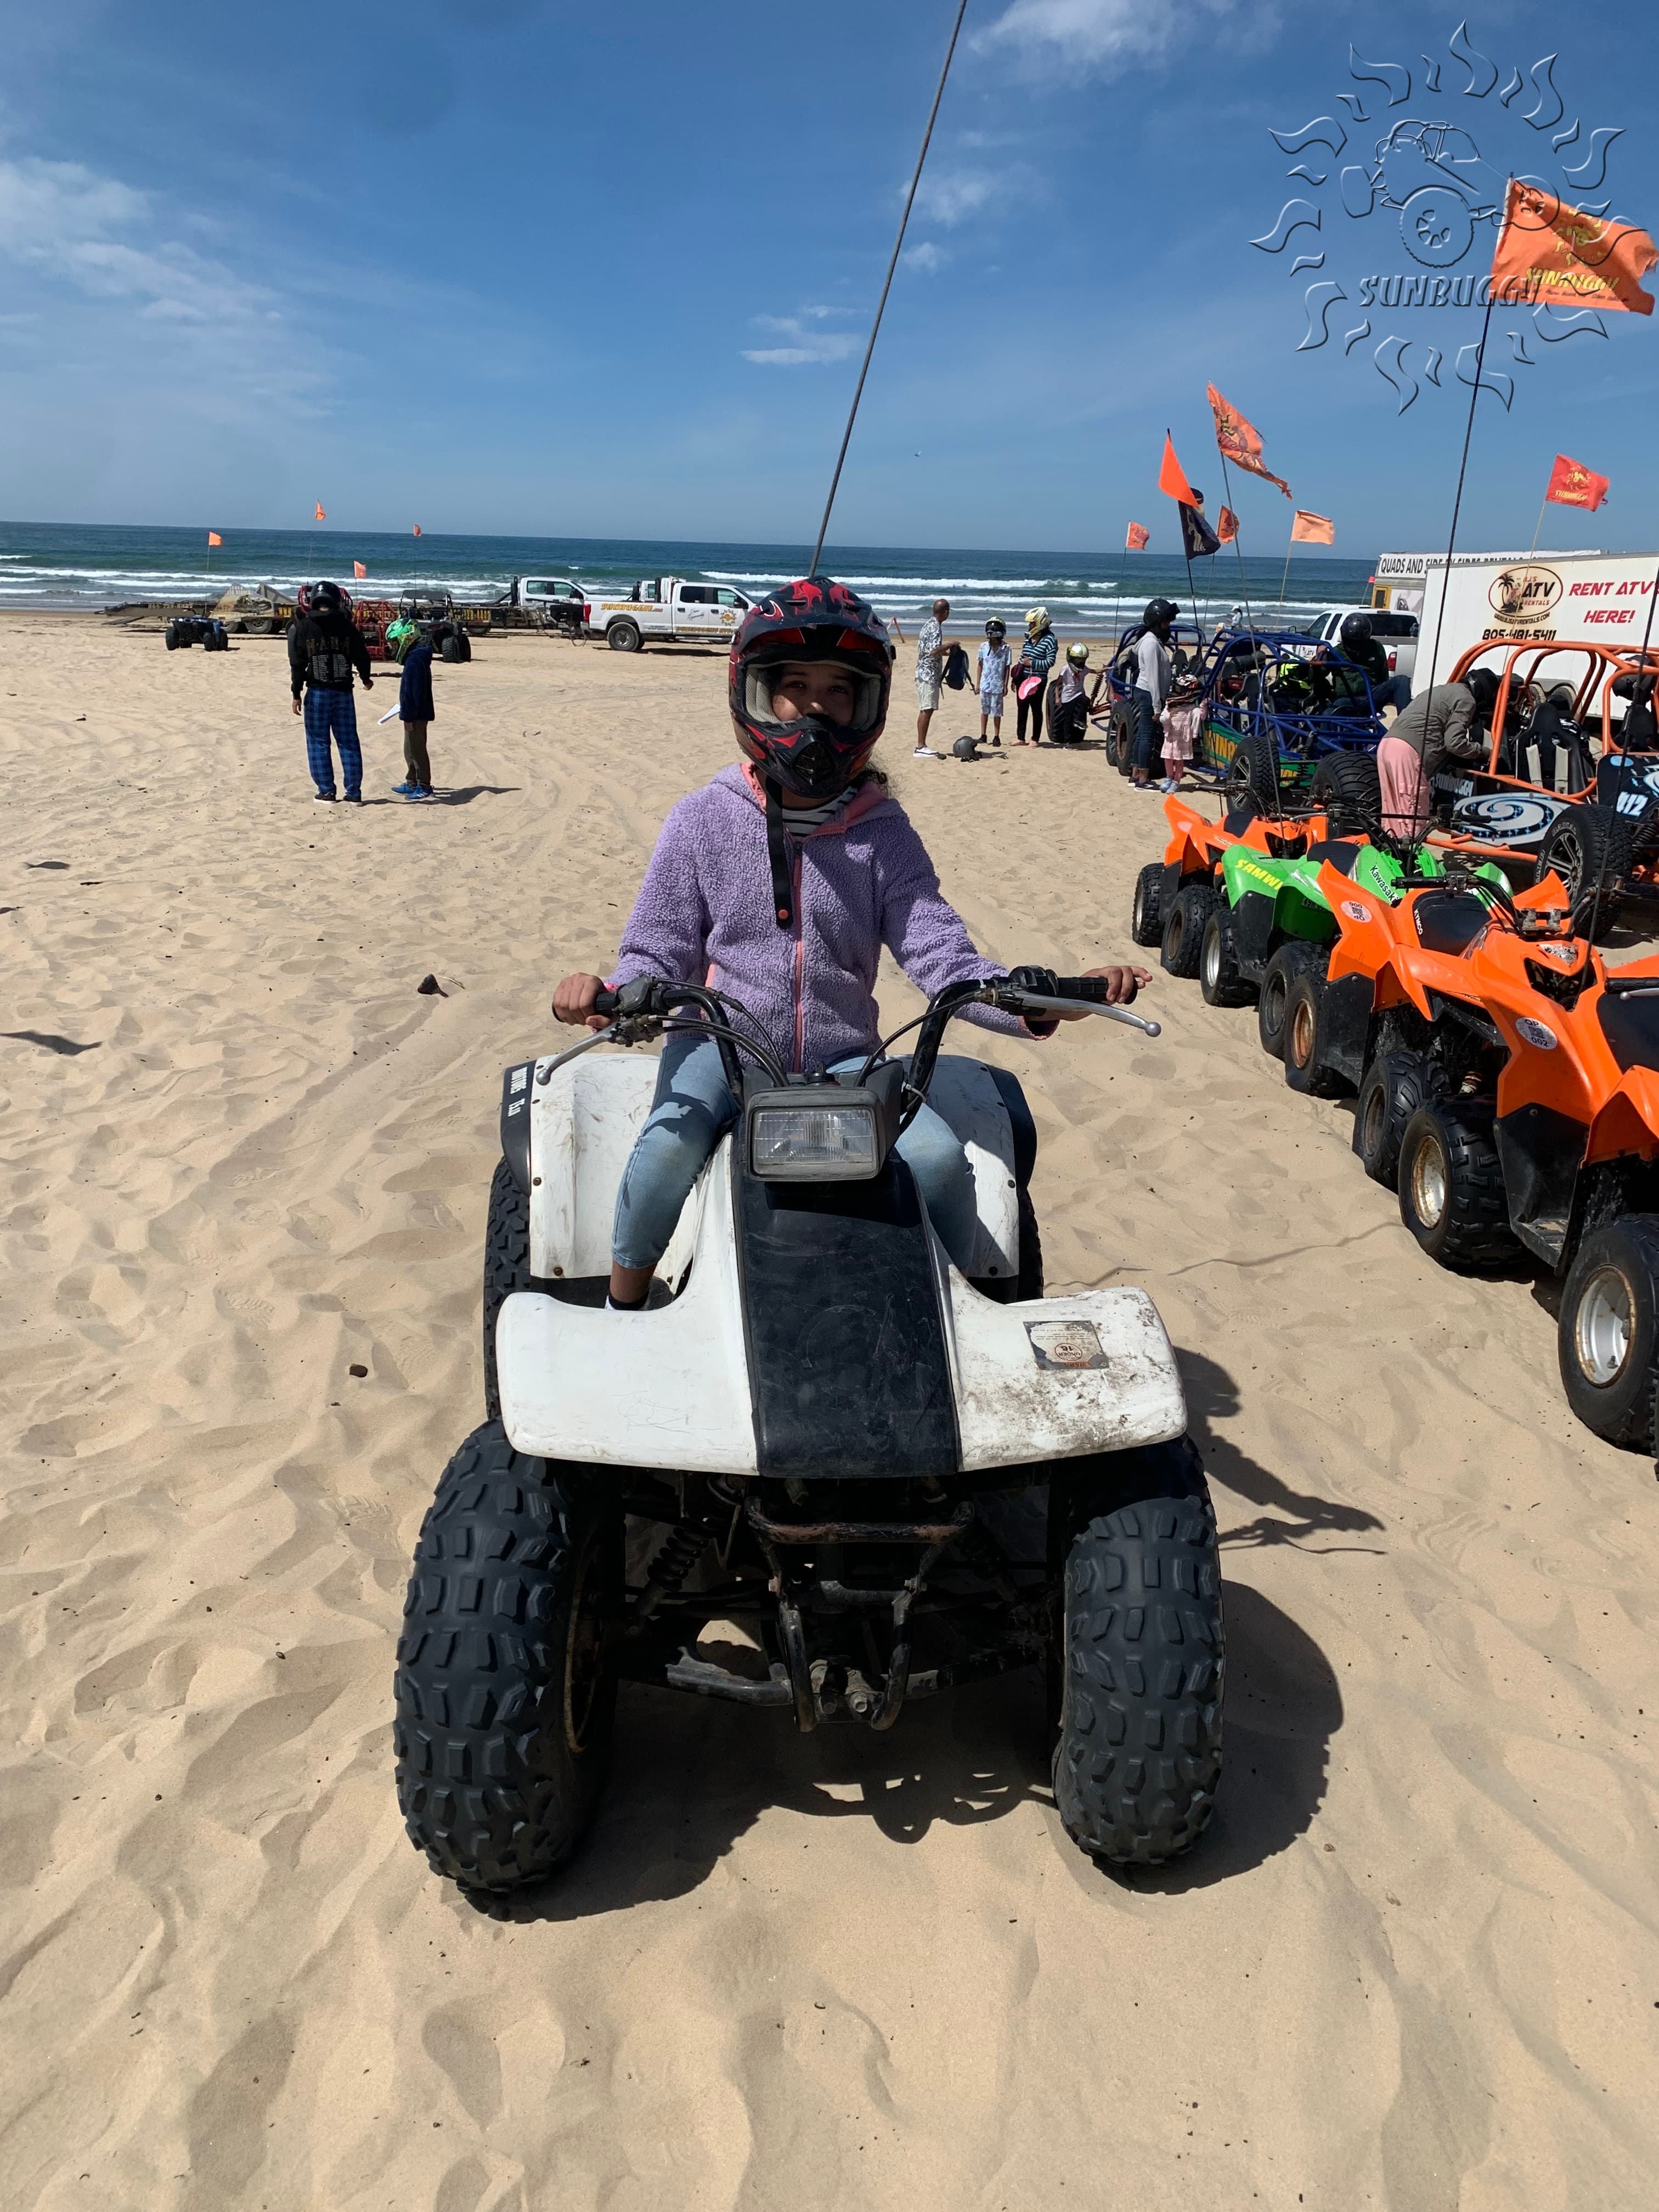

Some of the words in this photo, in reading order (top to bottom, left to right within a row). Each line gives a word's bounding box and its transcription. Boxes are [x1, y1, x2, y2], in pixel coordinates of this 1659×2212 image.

[1381, 558, 1404, 574] QUADS
[1406, 558, 1424, 574] AND
[1522, 582, 1556, 598] ATV
[1568, 582, 1615, 596] RENT
[1583, 610, 1636, 624] HERE!
[1482, 629, 1558, 641] 805-481-5411
[1370, 865, 1400, 903] Kawasaki
[1414, 908, 1423, 935] KYMCO
[1531, 1036, 1549, 1047] 002
